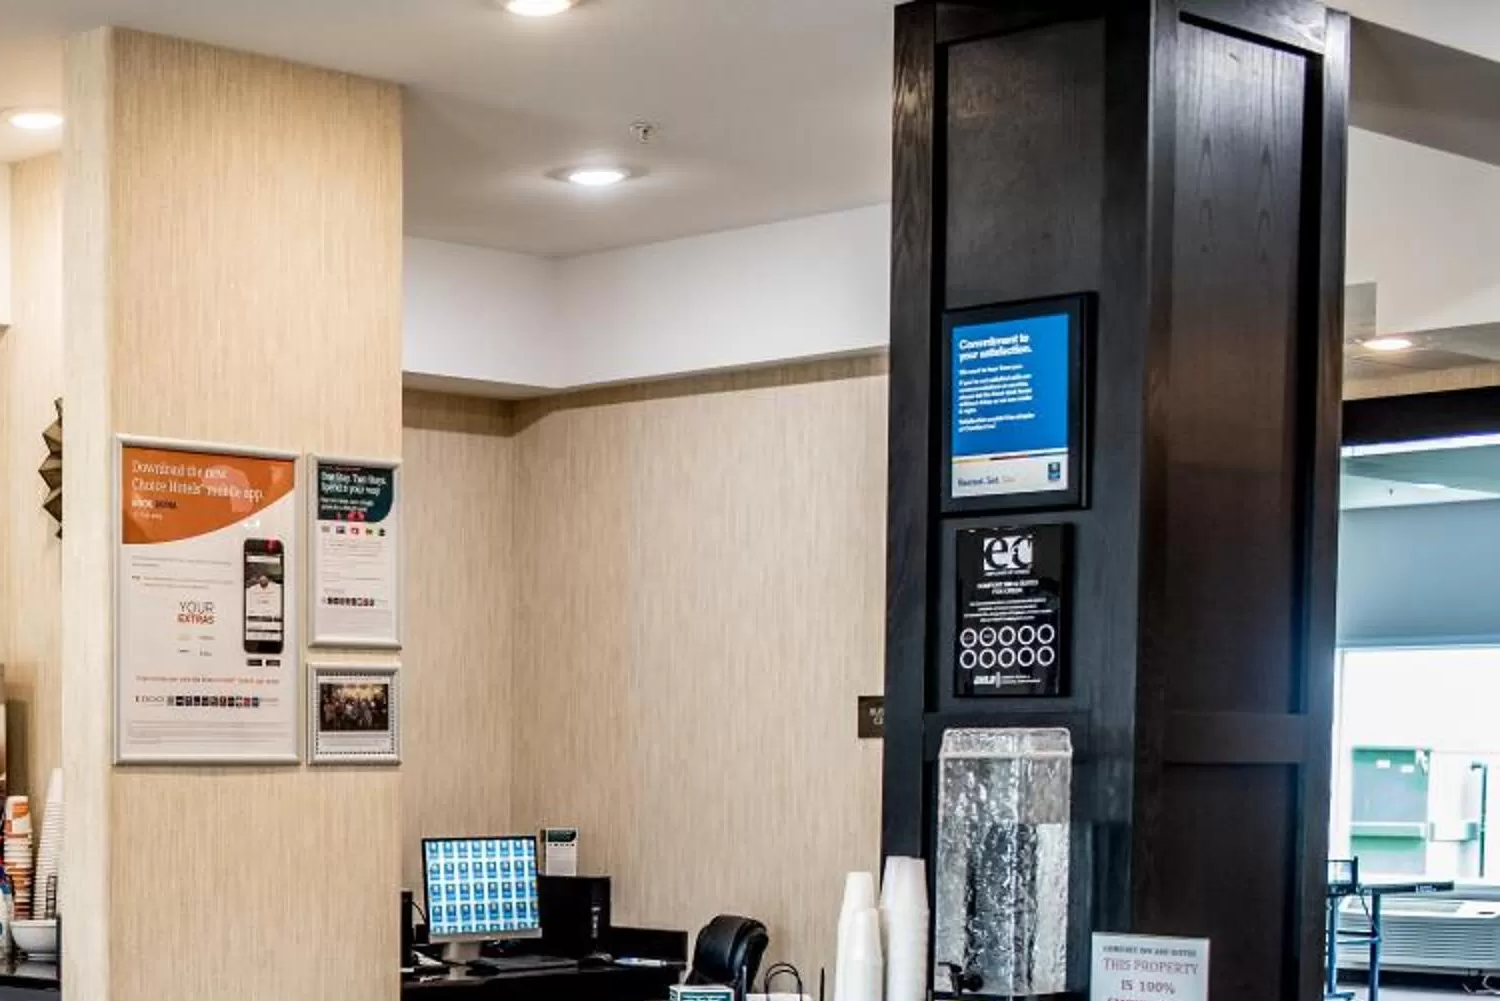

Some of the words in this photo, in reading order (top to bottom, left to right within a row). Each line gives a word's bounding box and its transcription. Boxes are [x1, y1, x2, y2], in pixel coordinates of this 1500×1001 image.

[179, 601, 215, 613] YOUR
[177, 613, 215, 625] EXTRAS
[1103, 957, 1132, 972] THIS
[1133, 959, 1199, 975] PROPERTY
[1121, 979, 1133, 991] IS
[1140, 981, 1176, 995] 100%
